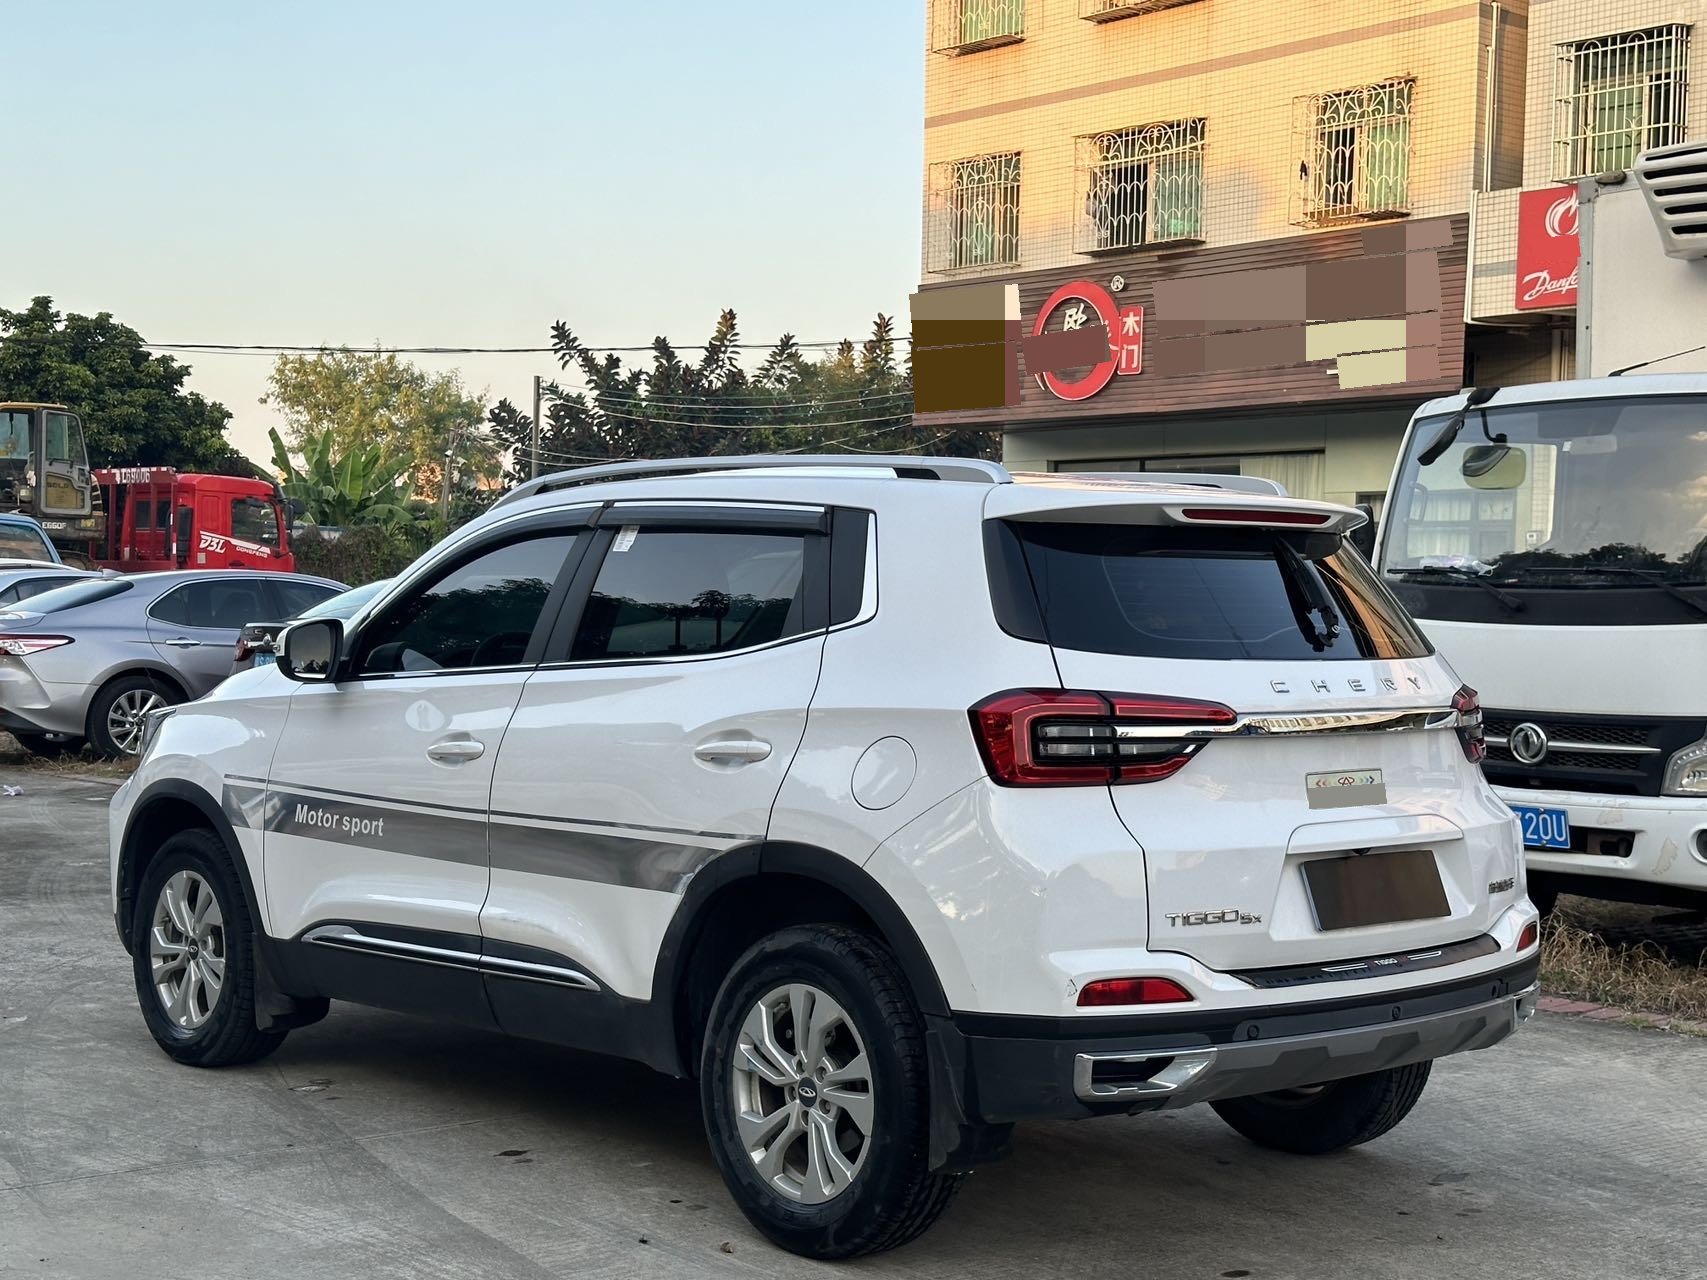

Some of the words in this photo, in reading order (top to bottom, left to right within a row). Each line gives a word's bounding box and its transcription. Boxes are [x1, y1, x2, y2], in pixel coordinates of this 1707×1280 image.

[1522, 266, 1578, 301] Danfo
[1121, 311, 1140, 369] 木门
[1270, 677, 1421, 693] CHERY
[295, 803, 340, 829] Motor
[342, 815, 384, 837] sport
[1514, 811, 1567, 842] 20U
[1164, 908, 1239, 928] TIGGO
